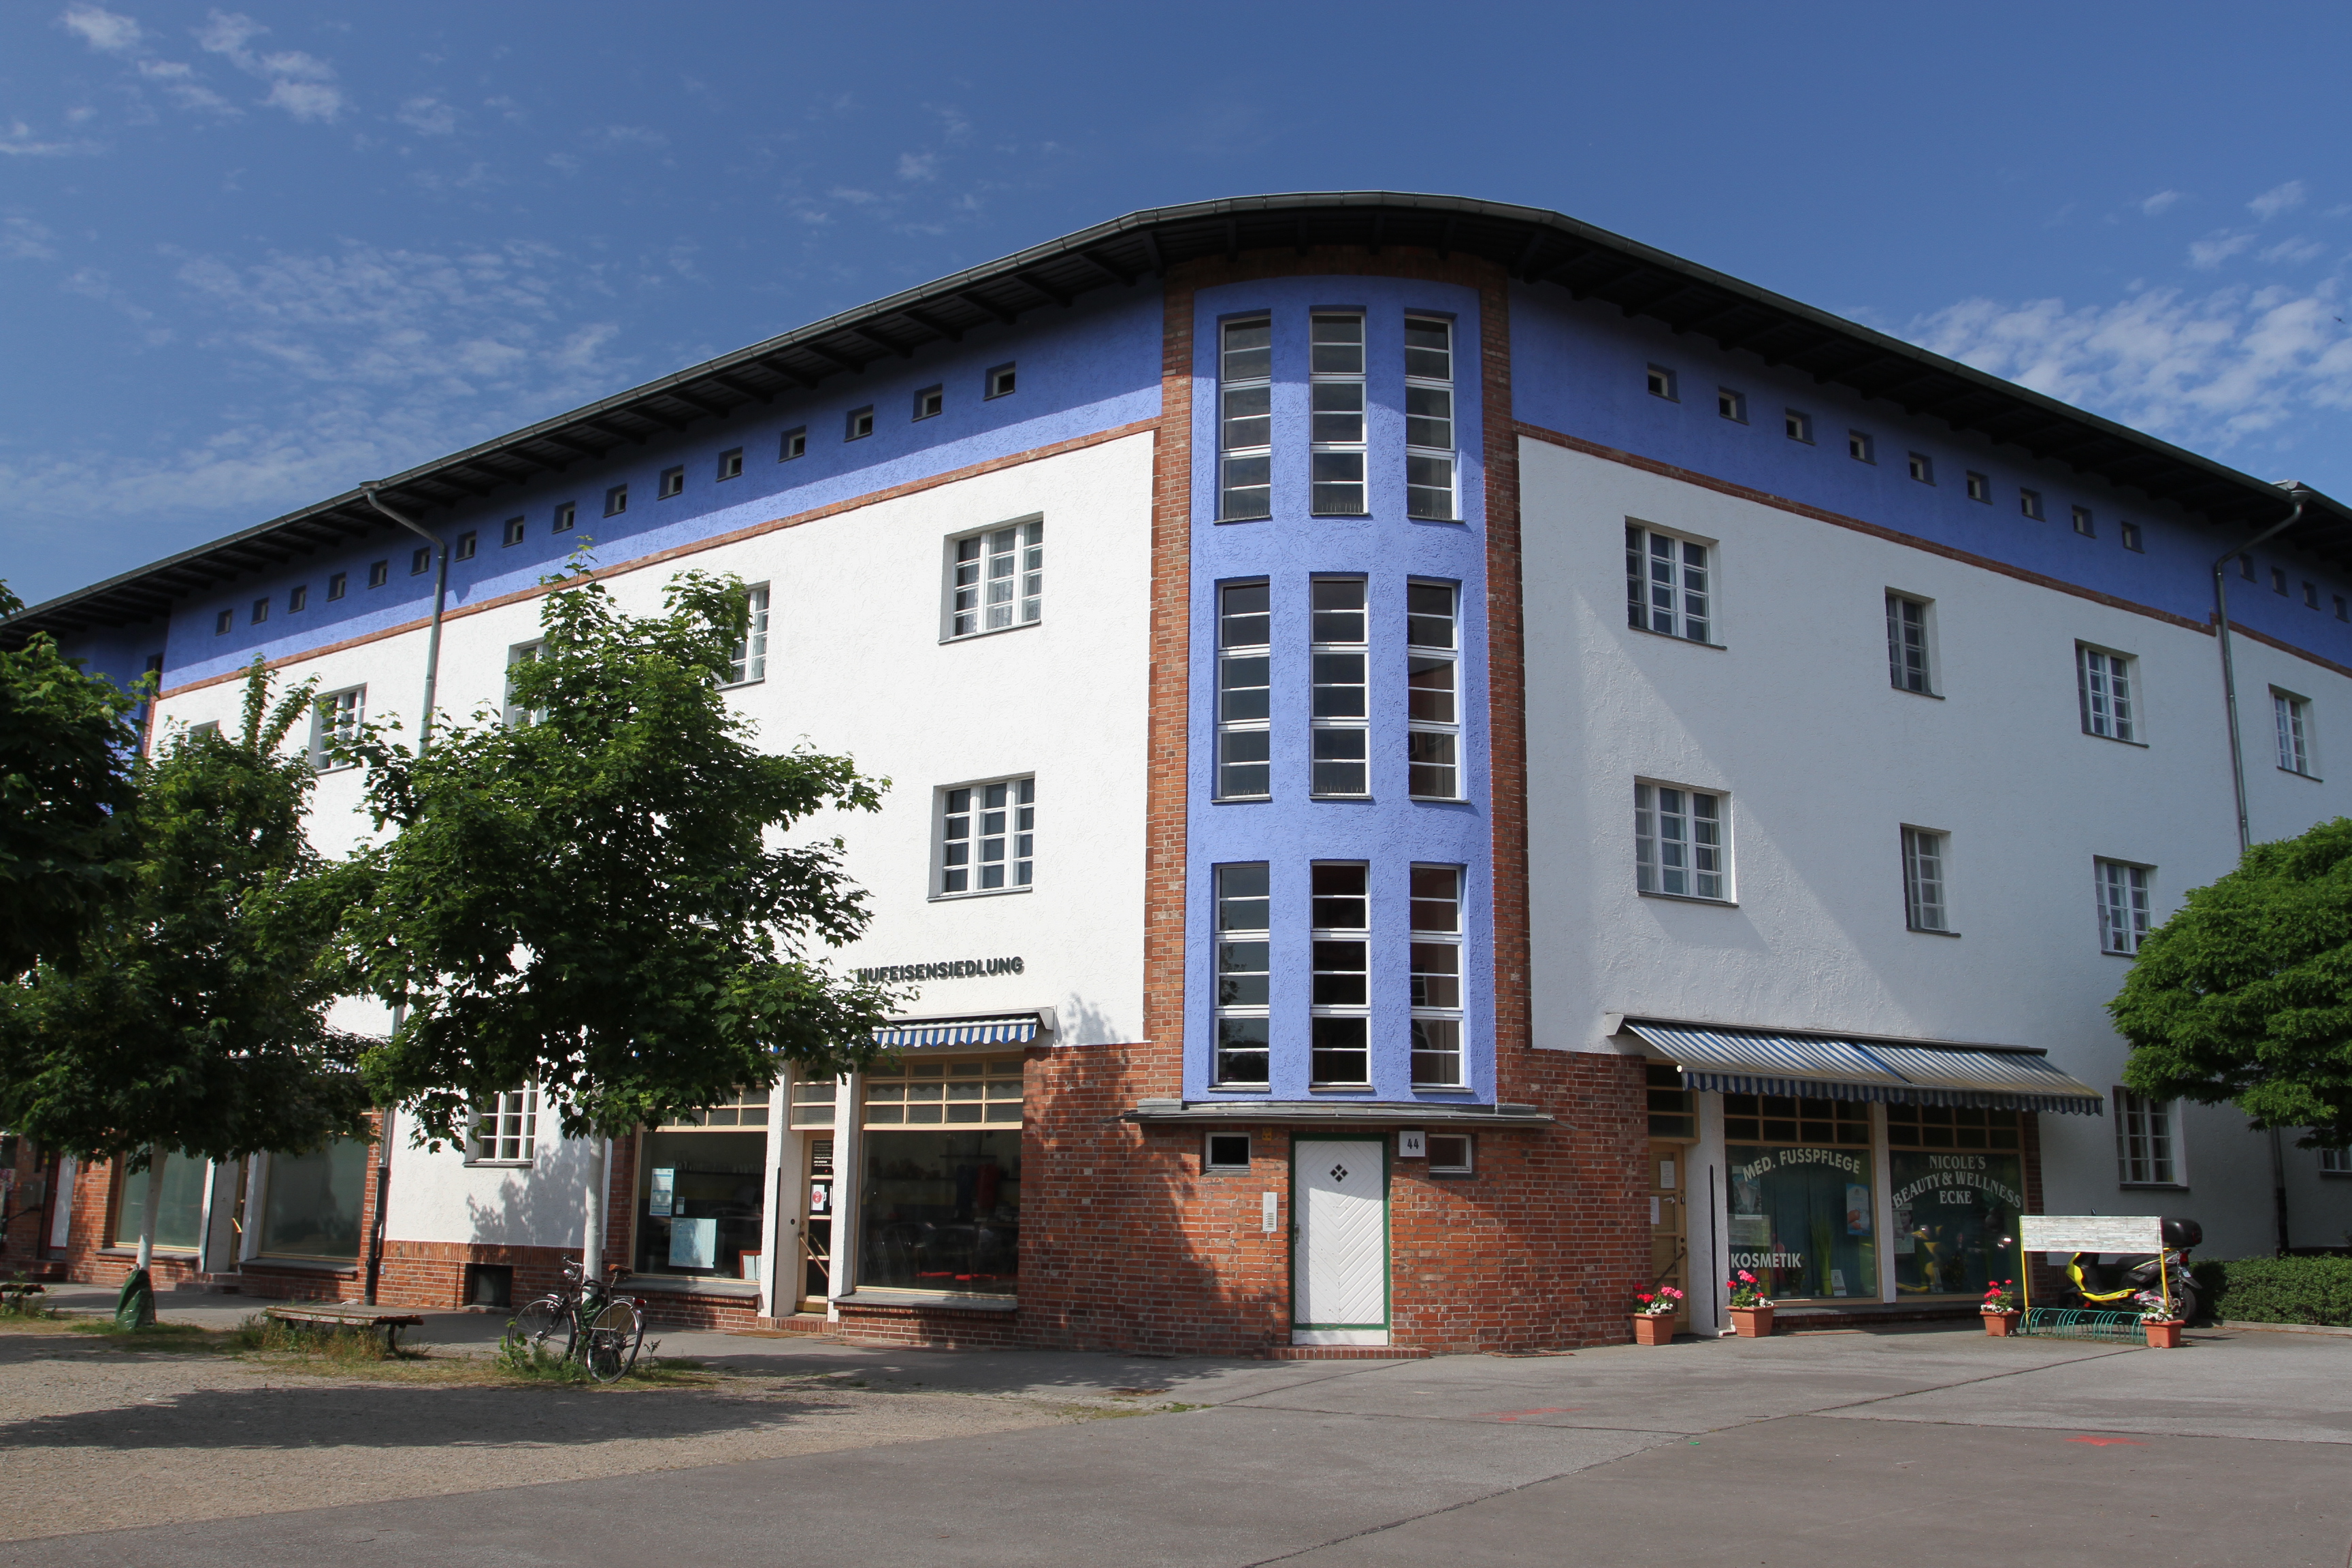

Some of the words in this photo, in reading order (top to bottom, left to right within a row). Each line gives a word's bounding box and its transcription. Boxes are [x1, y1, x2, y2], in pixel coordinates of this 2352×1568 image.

[857, 956, 1024, 984] HUFEISENSIEDLUNG
[1407, 1138, 1420, 1149] 44
[1742, 1156, 1776, 1182] MED.
[1779, 1148, 1861, 1175] FUSSPFLEGE
[1892, 1173, 1940, 1209] BEAUTY
[1942, 1171, 1953, 1186] &
[1955, 1171, 2022, 1209] WELLNESS
[1940, 1190, 1972, 1204] ECKE
[1731, 1253, 1802, 1268] KOSMETIK
